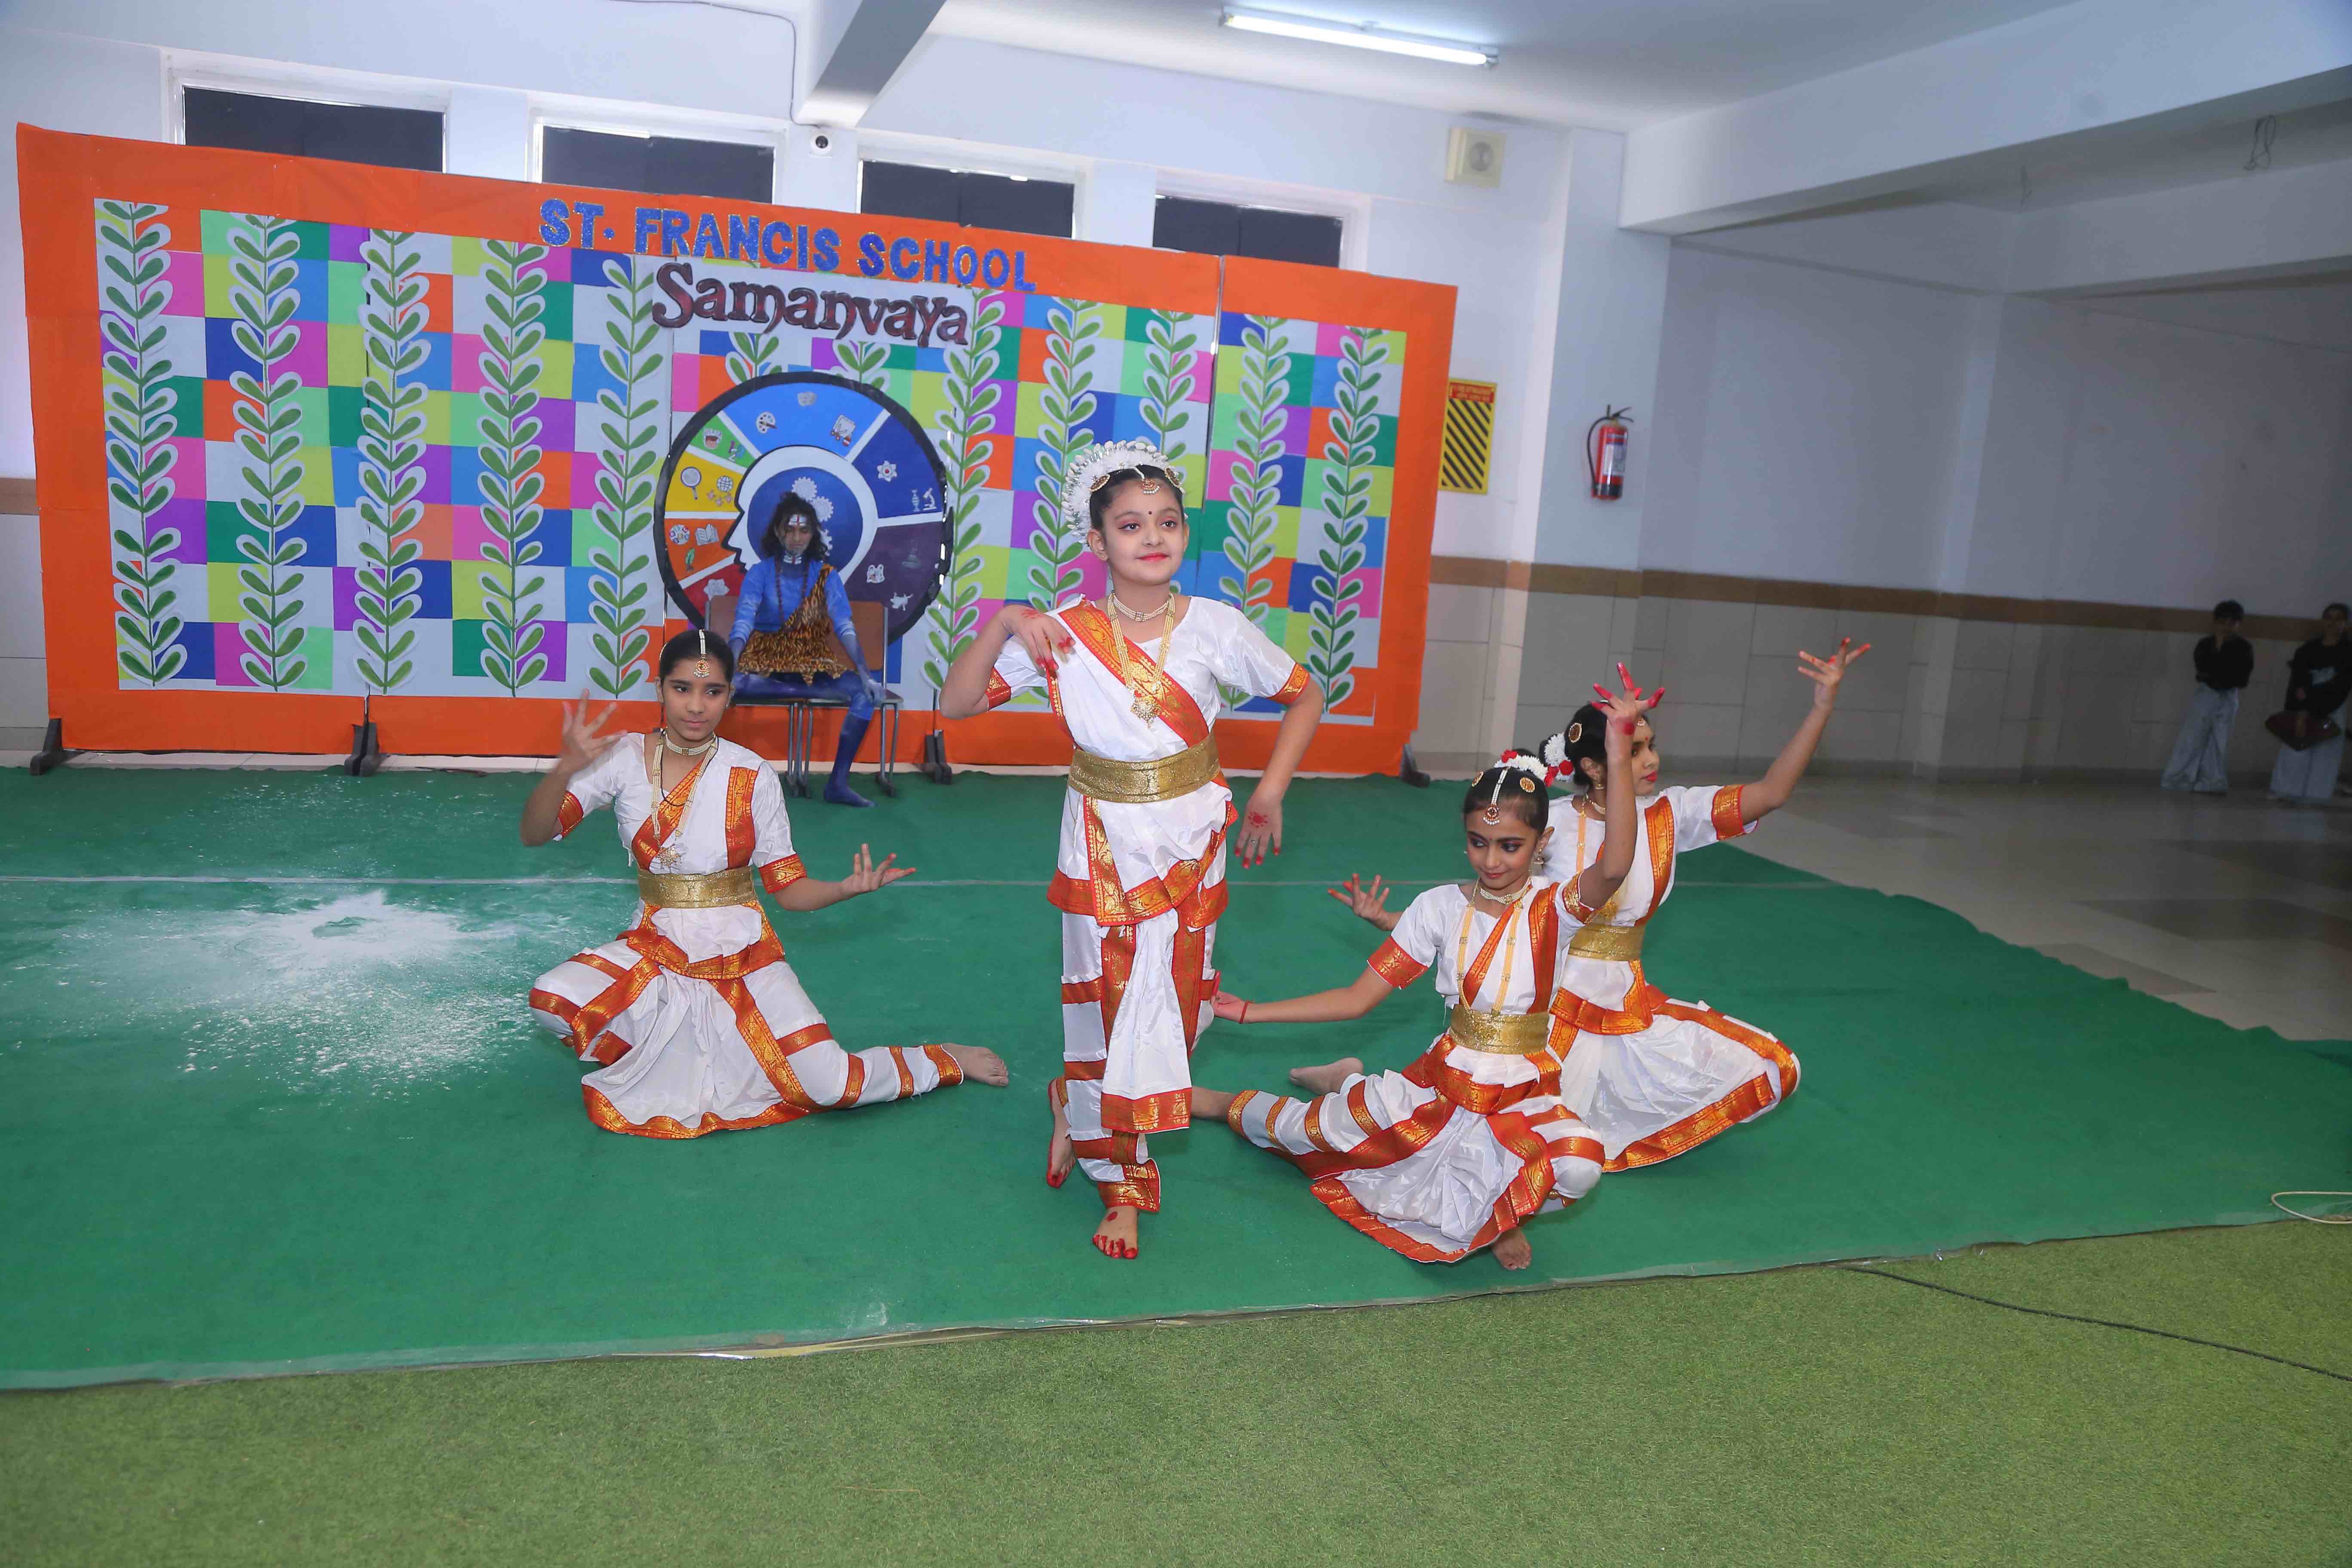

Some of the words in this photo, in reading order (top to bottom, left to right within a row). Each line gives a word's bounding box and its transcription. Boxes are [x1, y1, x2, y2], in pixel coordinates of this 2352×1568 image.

[539, 198, 615, 250] ST.
[634, 206, 842, 272] FRANCIS
[857, 231, 1038, 291] SCHOOL
[652, 262, 968, 347] Samanvaya
